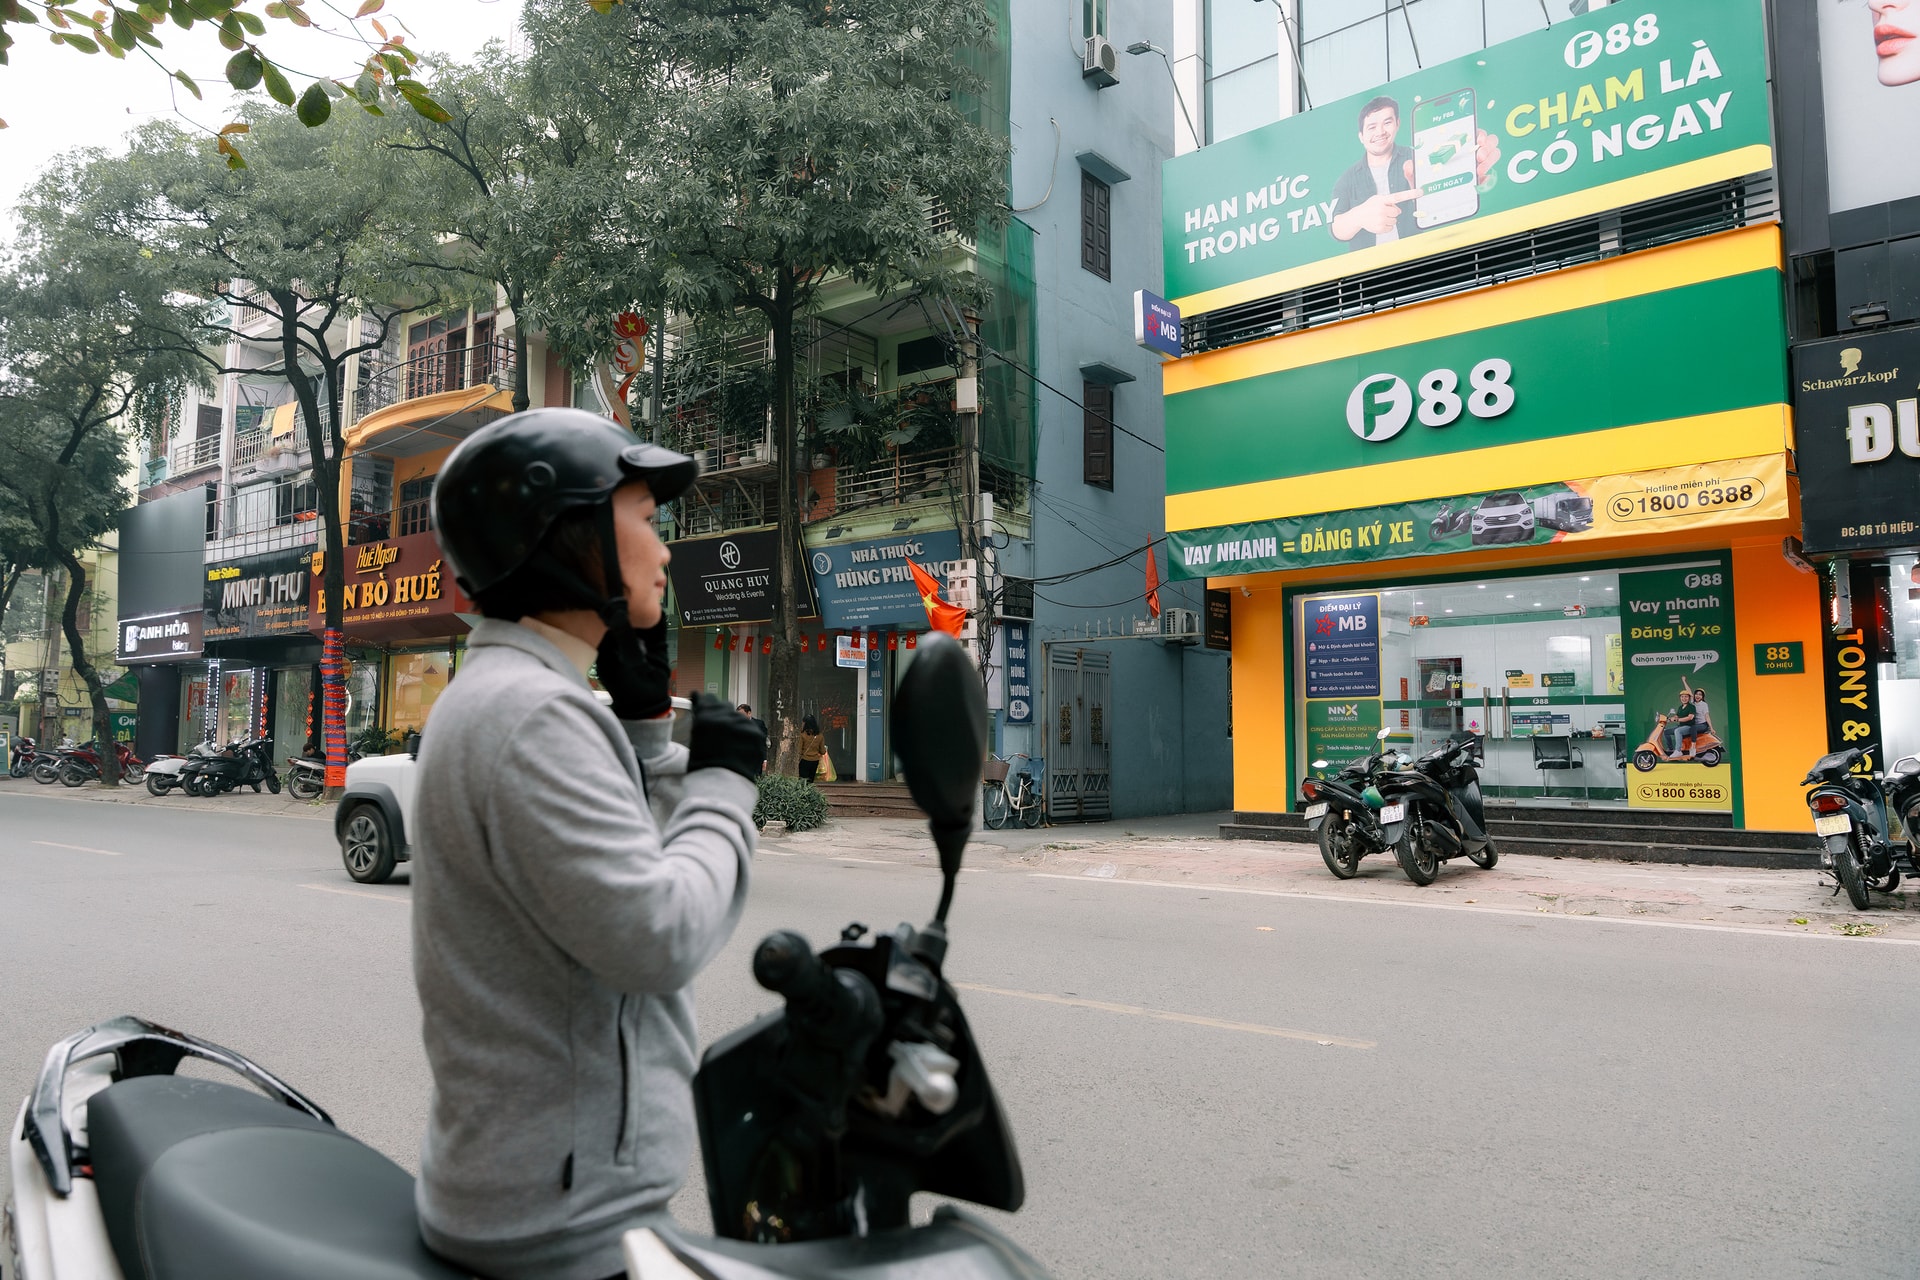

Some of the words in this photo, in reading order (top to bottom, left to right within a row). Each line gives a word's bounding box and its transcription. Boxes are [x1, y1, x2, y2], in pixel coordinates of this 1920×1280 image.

[1563, 13, 1660, 69] F88
[1505, 68, 1645, 137] CHẠM
[1659, 39, 1722, 94] LÀ
[1507, 129, 1578, 184] CÓ
[1591, 91, 1733, 163] NGAY
[1428, 181, 1441, 192] RÚT
[1443, 176, 1464, 188] NGAY
[1185, 196, 1238, 233] HẠN
[1245, 174, 1310, 214] MỨC
[1184, 217, 1280, 264] TRONG
[1286, 197, 1339, 234] TAY
[1160, 320, 1177, 341] MB
[1802, 368, 1899, 392] Schawarzkopf
[1346, 358, 1515, 441] F88
[1645, 484, 1678, 494] Hotline
[1705, 477, 1721, 488] phí
[1637, 493, 1689, 513] 1800
[1697, 484, 1753, 507] 6388
[1841, 527, 1858, 537] ĐC:
[1859, 524, 1873, 536] 86
[1874, 522, 1888, 534] TÔ
[1889, 521, 1914, 535] HIỆU
[851, 545, 879, 563] NHÀ
[880, 539, 925, 560] THUỐC
[1183, 544, 1213, 566] VAY
[1216, 537, 1277, 563] NHANH
[1283, 541, 1295, 552] =
[1300, 527, 1353, 554] ĐĂNG
[1358, 520, 1383, 547] KÝ
[1389, 520, 1414, 544] XE
[316, 584, 358, 614] BN
[360, 572, 388, 608] BÒ
[394, 559, 441, 604] HUẾ
[704, 578, 743, 593] QUANG
[747, 575, 770, 587] HUY
[835, 568, 880, 588] HÙNG
[1684, 573, 1722, 588] F88
[222, 577, 265, 609] MINH
[715, 591, 740, 601] Wedding
[746, 590, 765, 598] Events
[1319, 603, 1337, 613] ĐIỂM
[1338, 604, 1352, 612] ĐẠI
[1629, 600, 1661, 614] Vay
[1665, 595, 1720, 610] nhanh
[1338, 615, 1367, 631] MB
[1631, 626, 1673, 640] Đăng
[1678, 623, 1696, 638] ký
[1701, 625, 1721, 635] xe
[1011, 627, 1023, 641] NHÀ
[1009, 644, 1026, 660] THUỐC
[1766, 646, 1790, 660] 88
[1010, 663, 1025, 678] HÙNG
[1836, 628, 1868, 710] TONY
[1841, 720, 1870, 742] &
[1655, 788, 1685, 798] 1800
[1689, 788, 1721, 798] 6388
